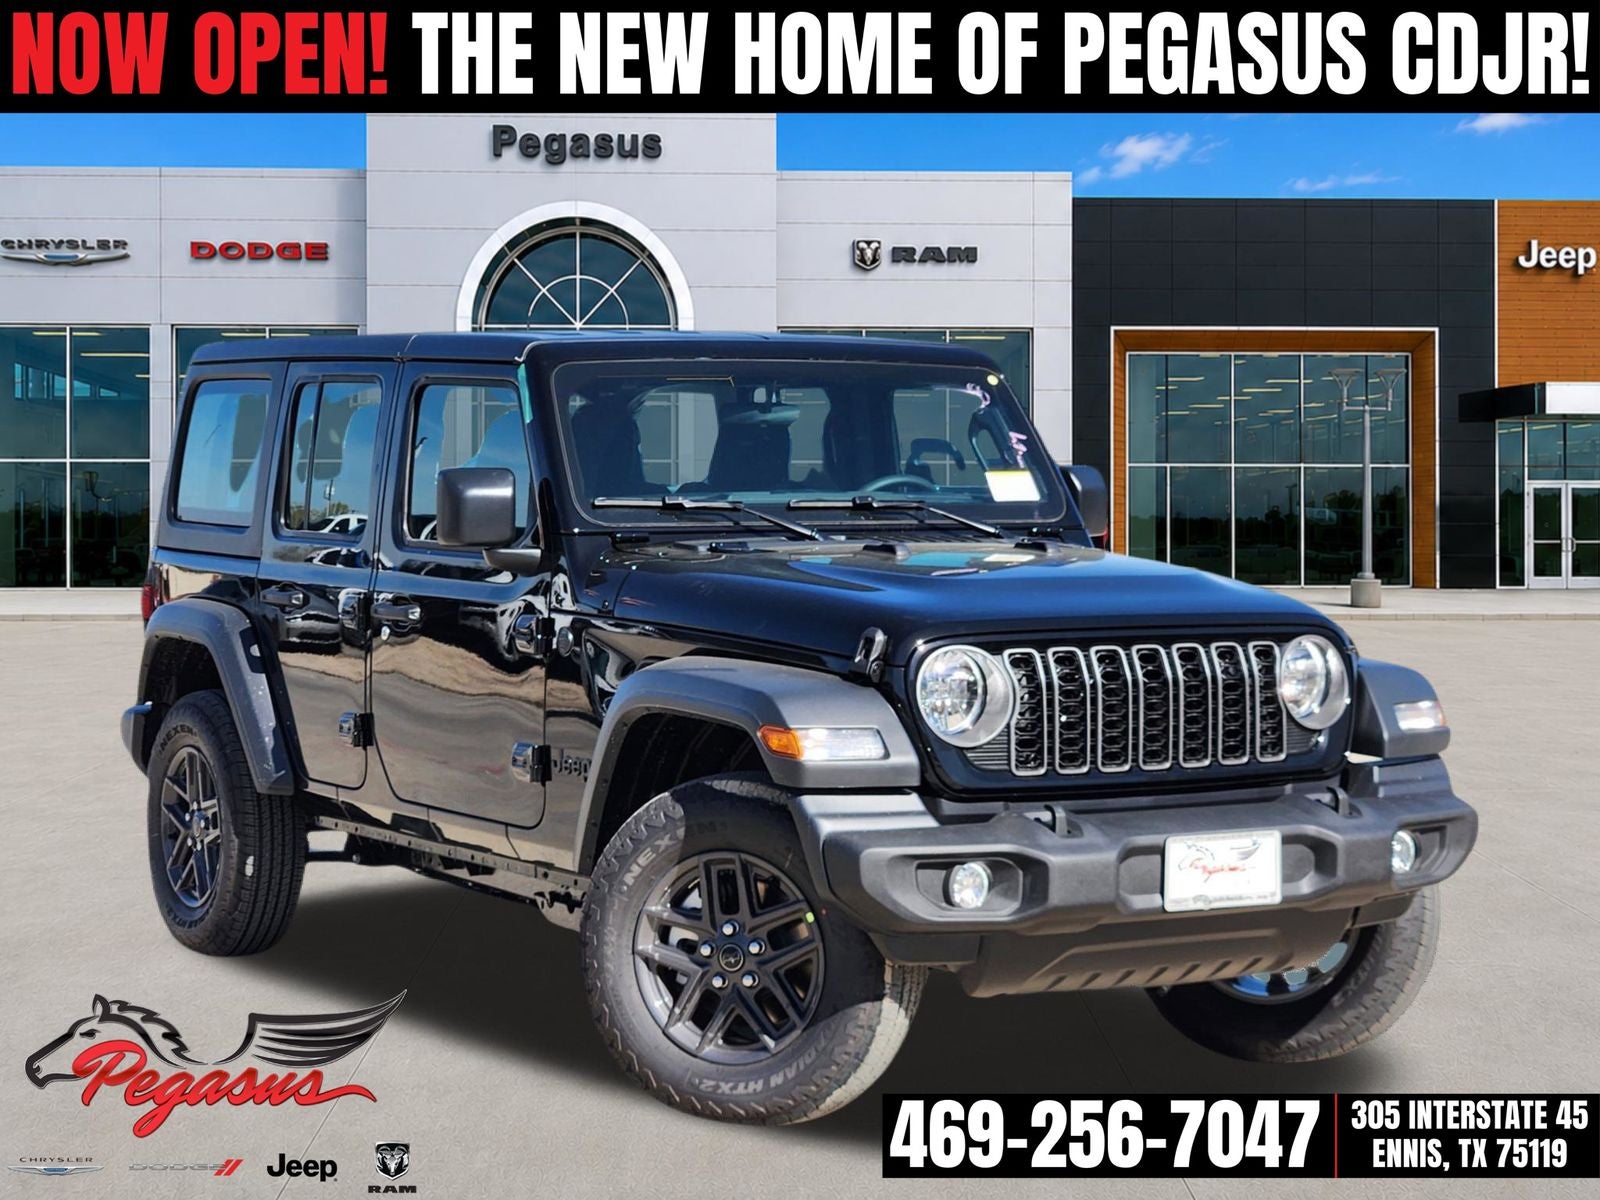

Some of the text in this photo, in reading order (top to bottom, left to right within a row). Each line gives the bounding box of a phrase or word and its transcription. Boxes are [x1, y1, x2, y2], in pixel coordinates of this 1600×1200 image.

[493, 125, 662, 166] Pegasus
[1, 239, 129, 250] CHRYSLER
[190, 241, 328, 260] DODGE
[891, 246, 978, 263] RAM
[1518, 239, 1597, 275] Jeep
